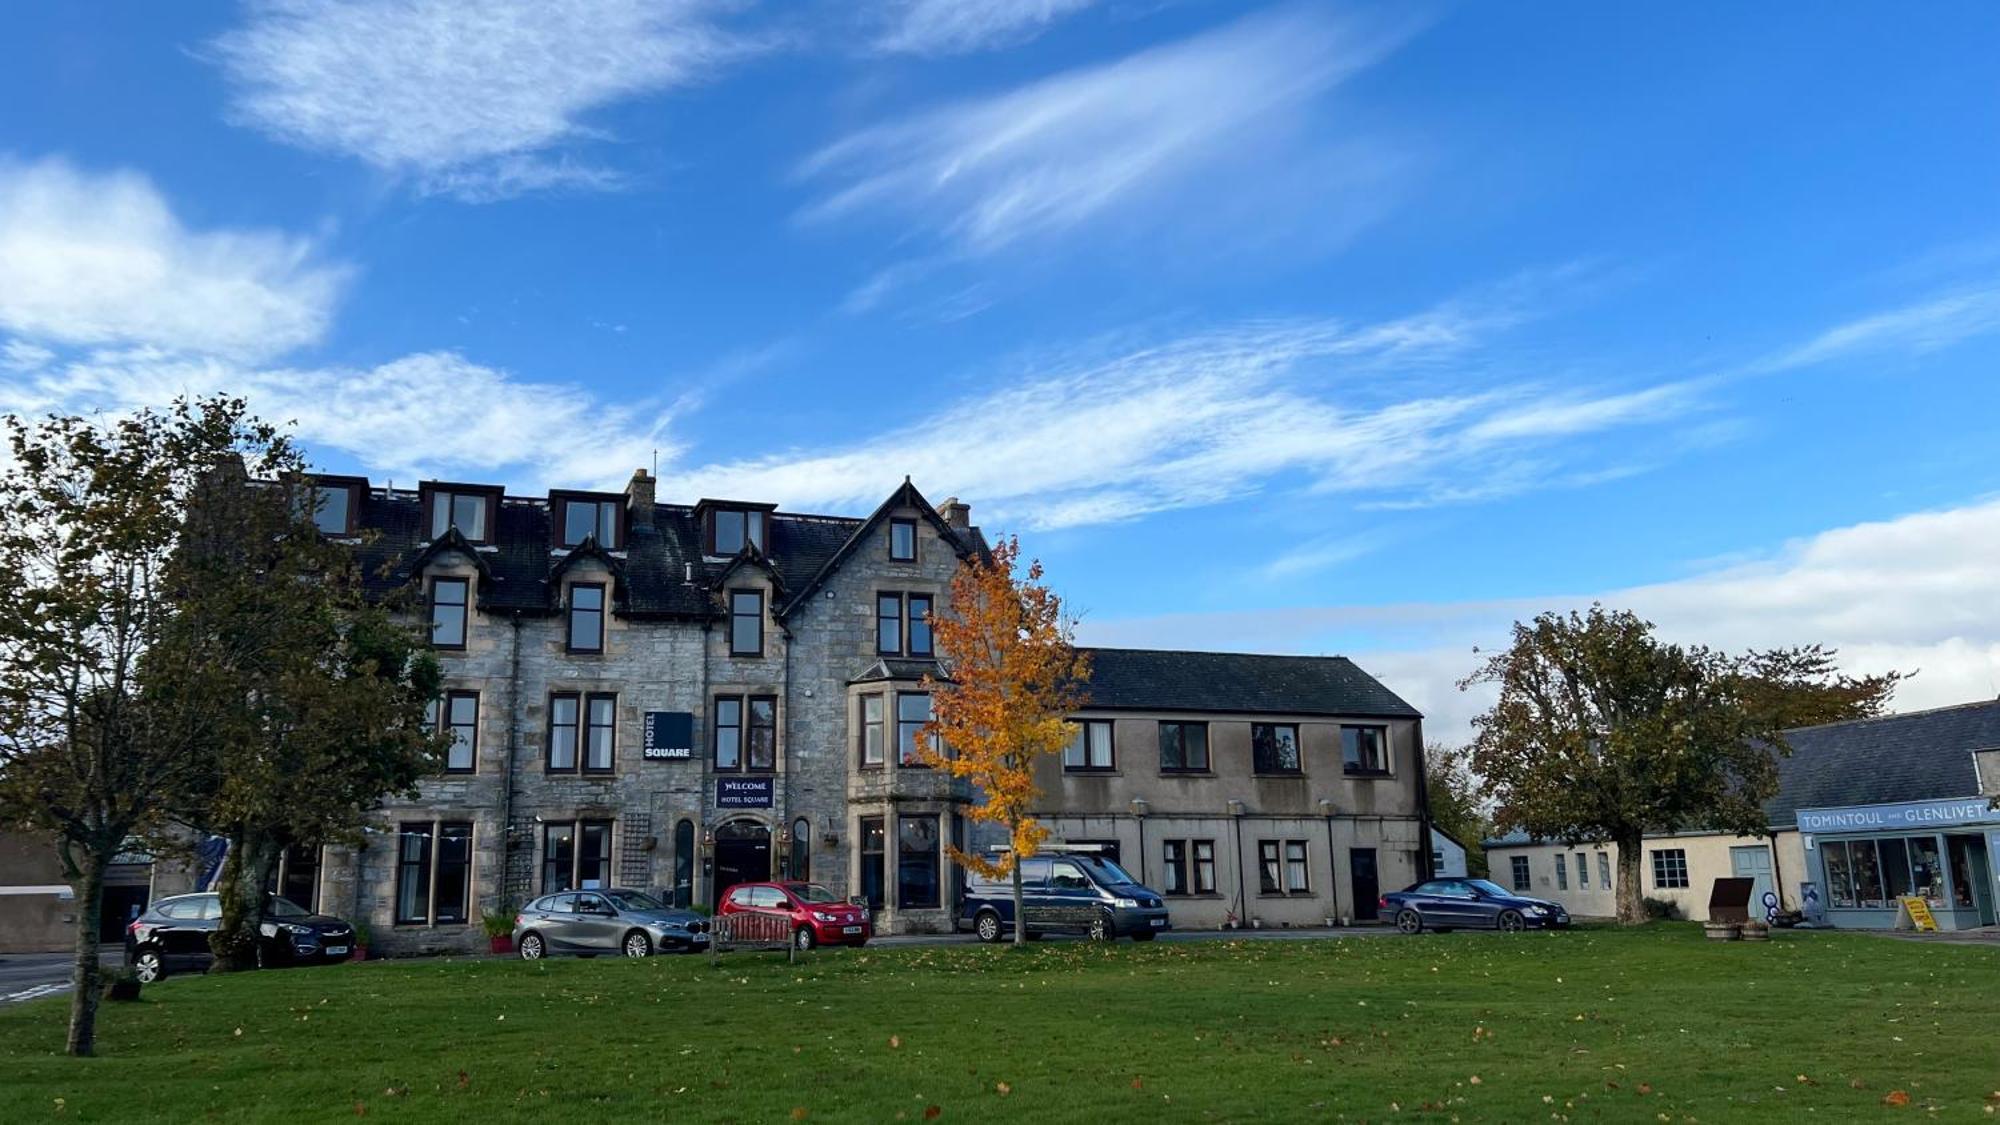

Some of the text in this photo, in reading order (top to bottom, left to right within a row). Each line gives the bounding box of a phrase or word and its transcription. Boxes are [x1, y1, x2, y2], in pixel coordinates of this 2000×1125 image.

[645, 713, 655, 747] HOTEL
[645, 748, 690, 757] SQUARE
[725, 782, 767, 791] WELCOME
[721, 796, 768, 804] HOTEL SQUARE
[1804, 812, 1883, 828] TOMINTOUL
[1904, 804, 1984, 822] GLENLIVET
